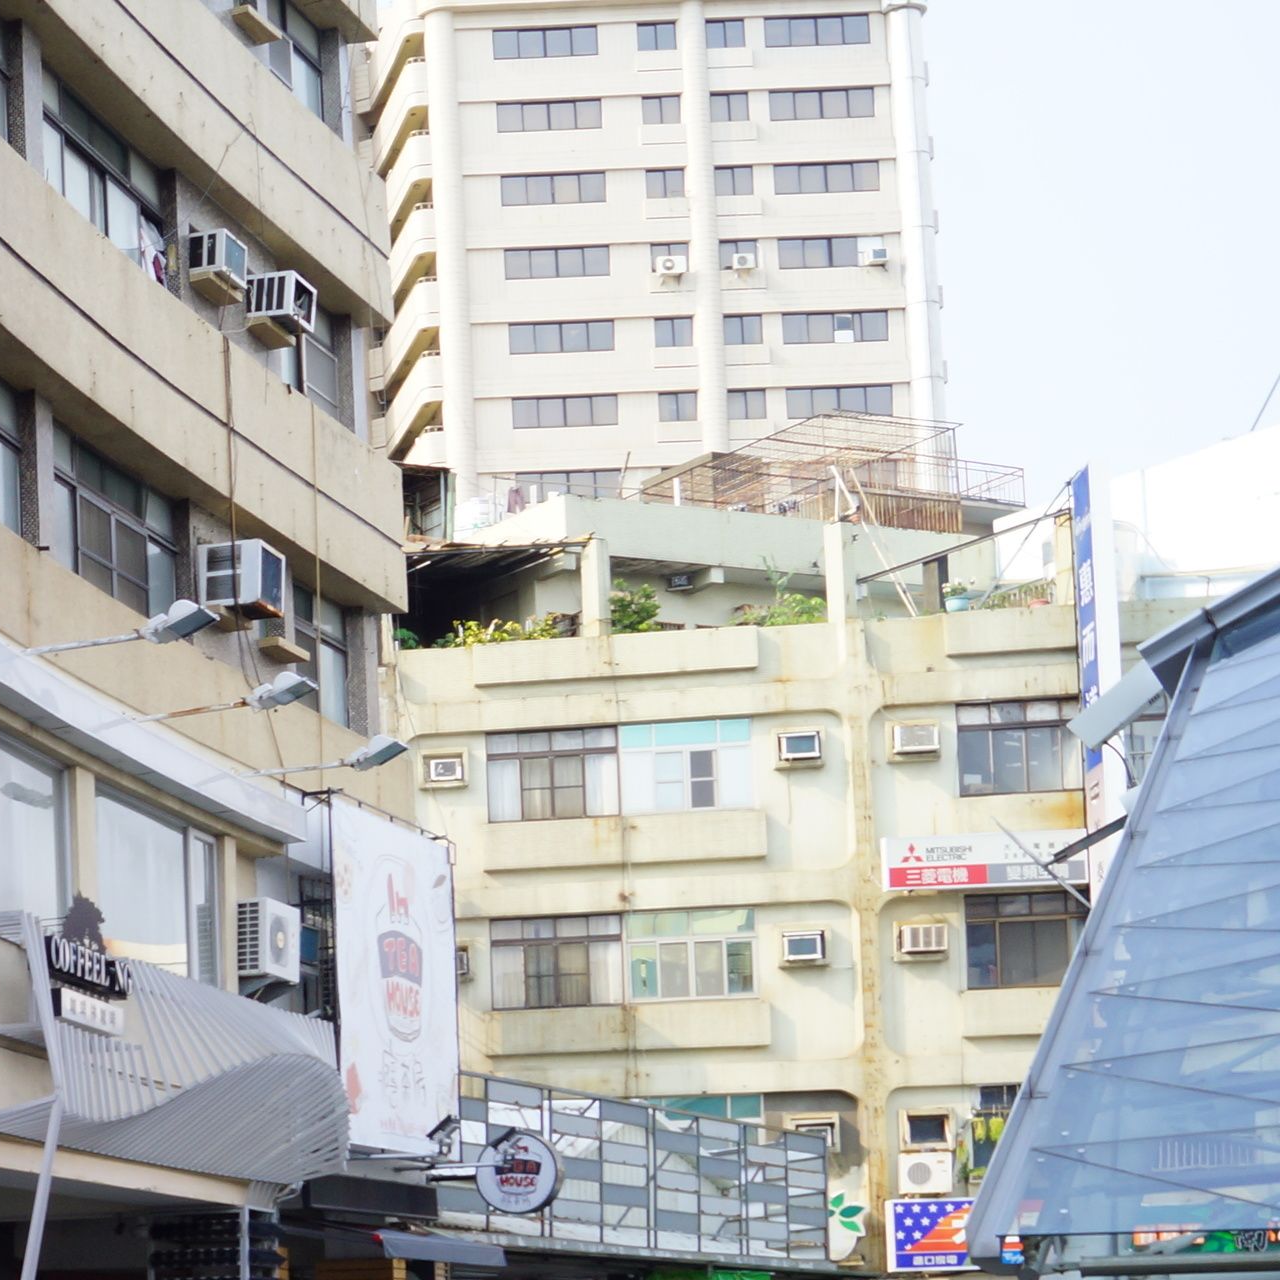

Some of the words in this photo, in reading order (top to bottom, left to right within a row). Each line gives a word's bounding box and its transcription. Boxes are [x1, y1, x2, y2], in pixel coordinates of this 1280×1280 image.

[925, 845, 973, 855] MITSUBISHI
[926, 852, 967, 862] ELECTRIC
[905, 867, 969, 885] 三菱電機
[383, 937, 420, 979] TEA
[385, 978, 421, 1019] HOUSE
[499, 1175, 536, 1188] HOUSE
